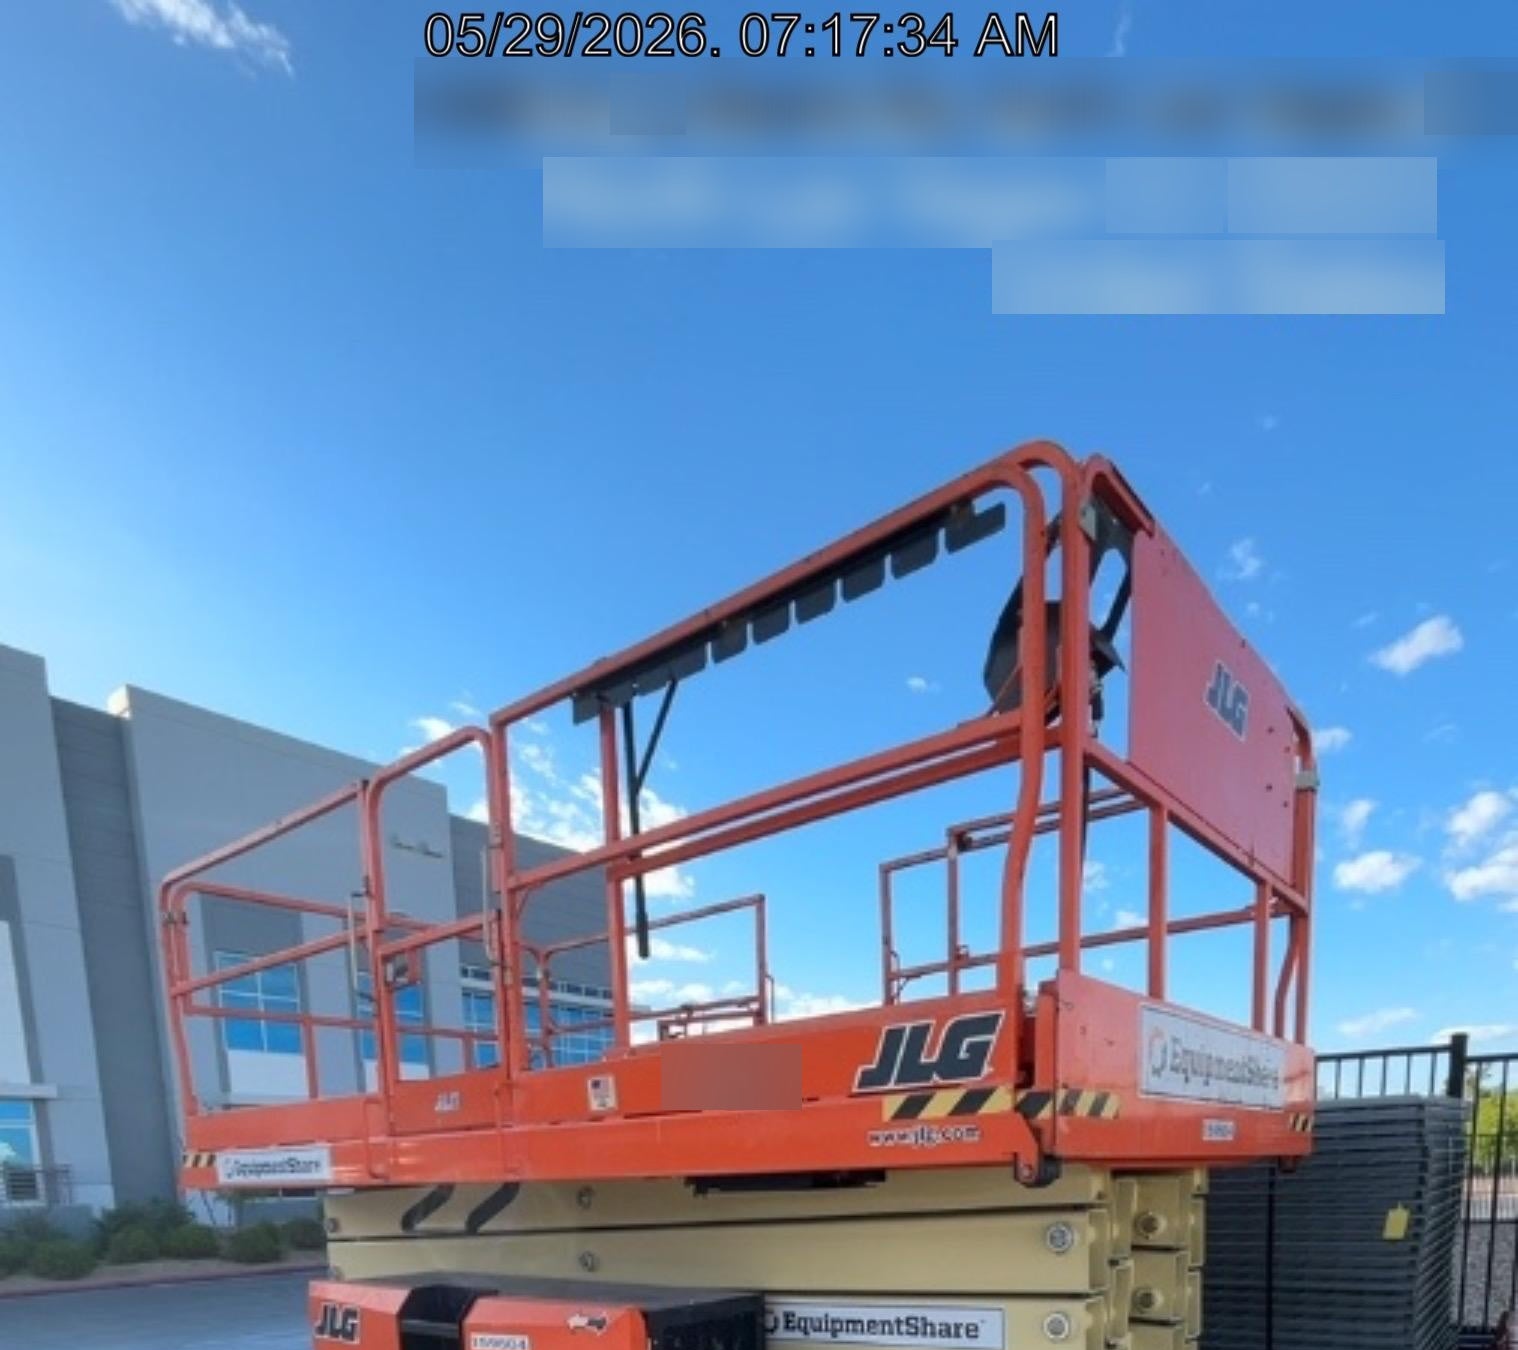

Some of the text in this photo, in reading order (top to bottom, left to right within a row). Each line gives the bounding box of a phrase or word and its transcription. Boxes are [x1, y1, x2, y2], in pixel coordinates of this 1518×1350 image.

[1204, 660, 1250, 741] JLG
[852, 1010, 1005, 1092] JLG
[313, 1302, 360, 1343] JLG
[783, 1310, 980, 1339] EquipmentShare
